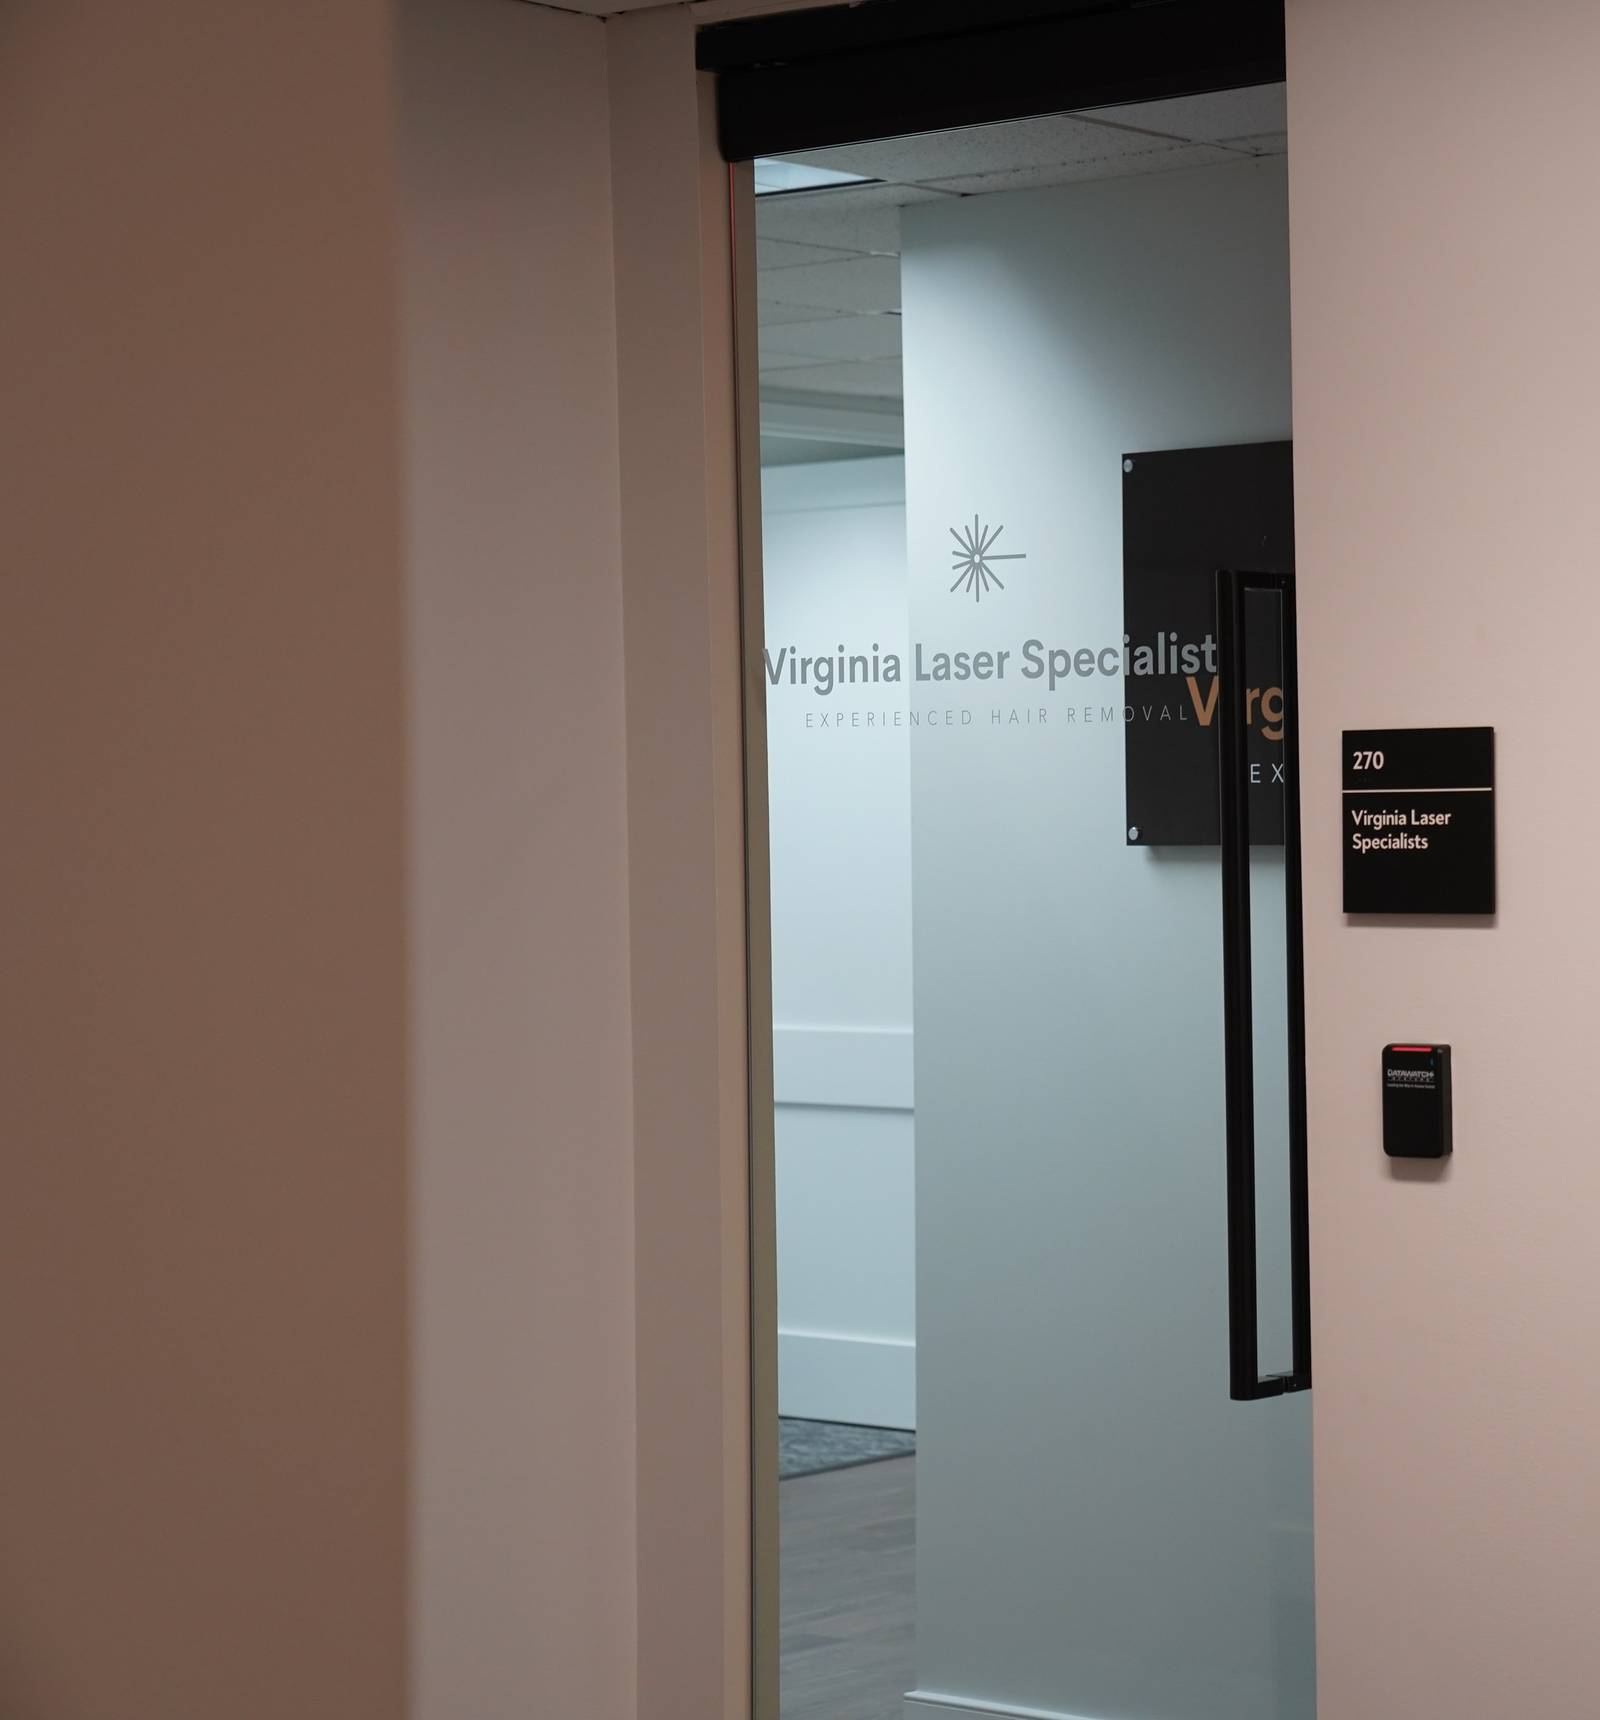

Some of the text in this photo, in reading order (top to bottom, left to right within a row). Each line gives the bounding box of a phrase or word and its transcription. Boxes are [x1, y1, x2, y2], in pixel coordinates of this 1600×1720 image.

[762, 631, 1217, 696] Virginia Laser Specialist
[805, 704, 1188, 729] EXPERIENCED HAIR REMOVAL
[1186, 676, 1284, 741] Vrg
[1352, 751, 1384, 770] 270
[1351, 809, 1452, 830] Virginia Laser
[1352, 832, 1429, 854] Specialists
